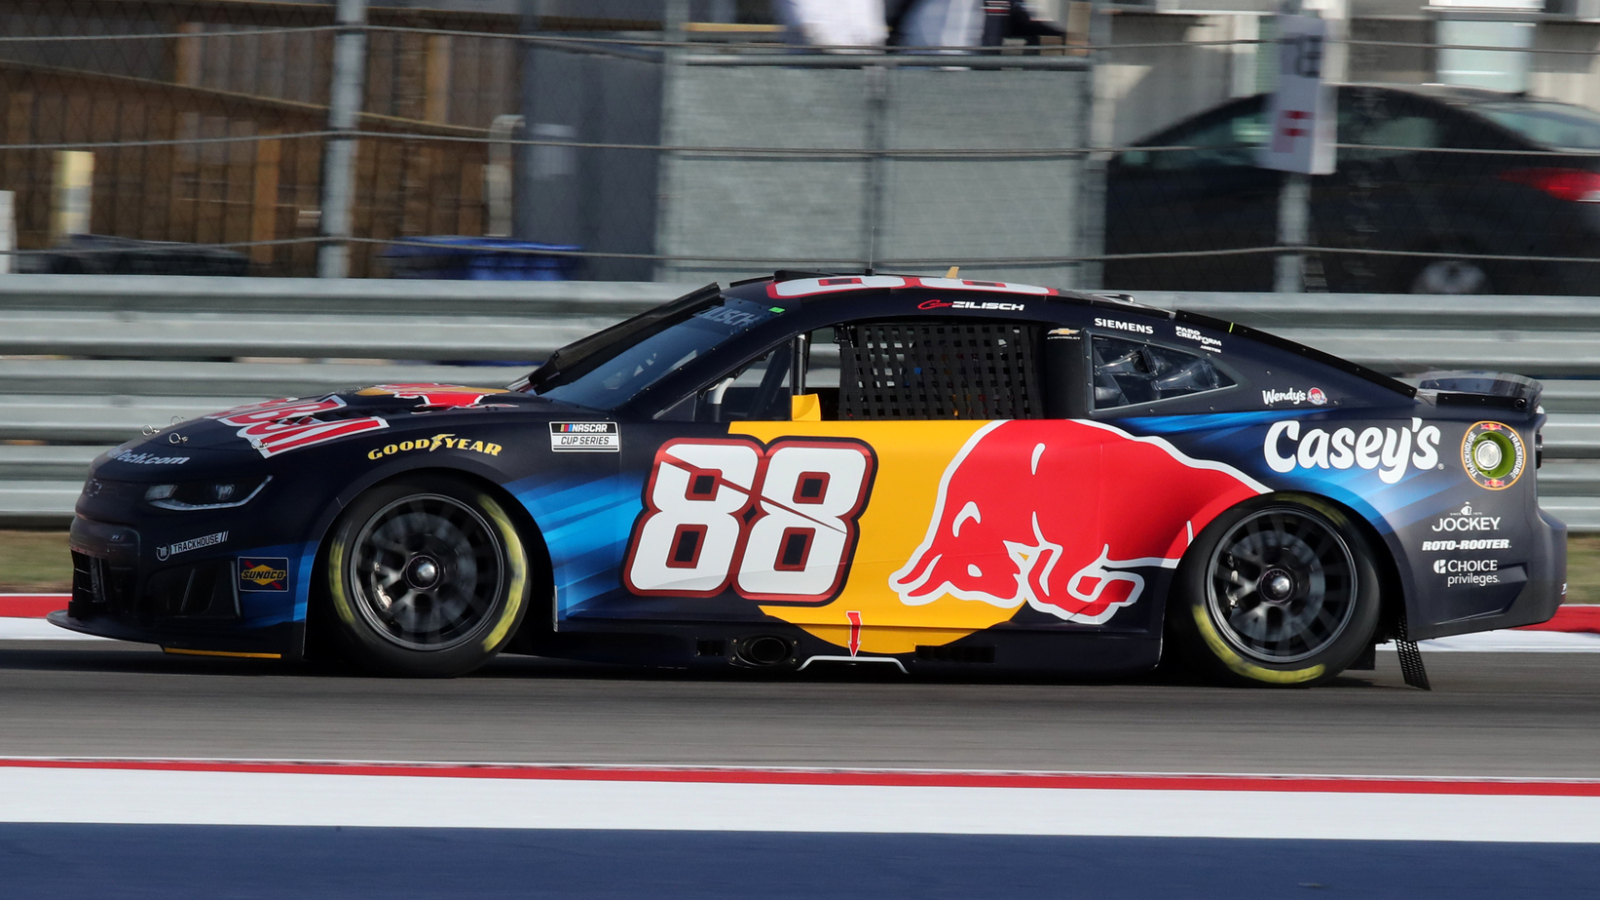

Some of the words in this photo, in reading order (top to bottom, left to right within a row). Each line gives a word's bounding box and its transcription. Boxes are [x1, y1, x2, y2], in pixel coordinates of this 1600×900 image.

[951, 301, 1025, 311] ZILISCH
[1094, 318, 1154, 335] SIEMENS
[1175, 331, 1222, 346] CREAFORM
[1262, 387, 1306, 405] Wendy's
[572, 423, 608, 433] NASCAR
[367, 434, 502, 460] GOODYEAR
[561, 436, 579, 445] CUP
[580, 436, 610, 445] SERIES
[1264, 417, 1441, 484] Casey's
[1464, 431, 1478, 478] TRACKHOUSE
[1508, 432, 1523, 479] TRACKHOUSE
[622, 437, 875, 604] 88
[1431, 517, 1501, 532] JOCKEY
[172, 534, 220, 554] TRACKHOUSE
[1422, 539, 1510, 551] ROTO-ROOTER
[1447, 560, 1498, 572] CHOICE
[242, 570, 286, 580] SUNOCO
[1447, 573, 1499, 588] privileges
